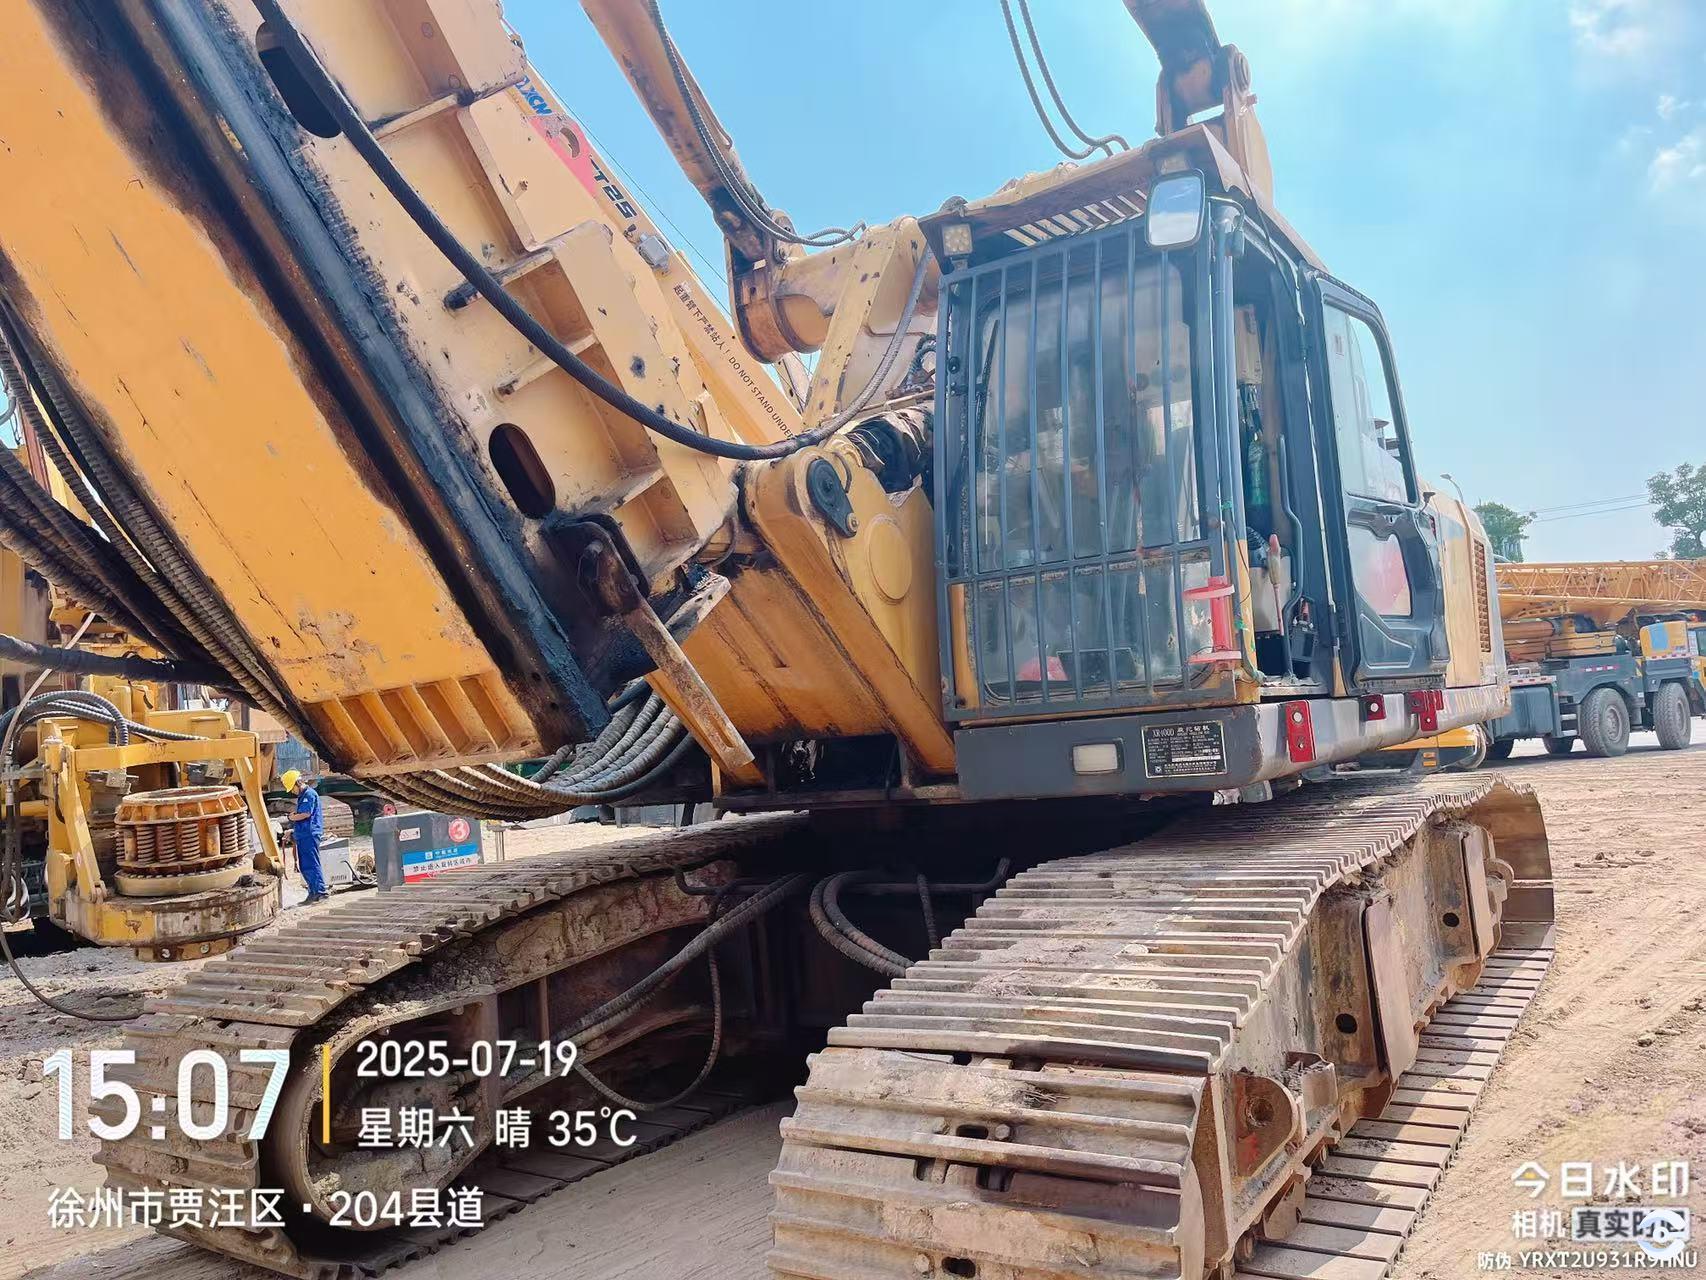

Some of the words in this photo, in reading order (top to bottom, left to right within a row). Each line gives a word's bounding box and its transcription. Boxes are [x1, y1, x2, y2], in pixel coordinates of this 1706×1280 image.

[727, 356, 741, 370] DO
[737, 368, 754, 387] NOT
[750, 385, 775, 414] STAND
